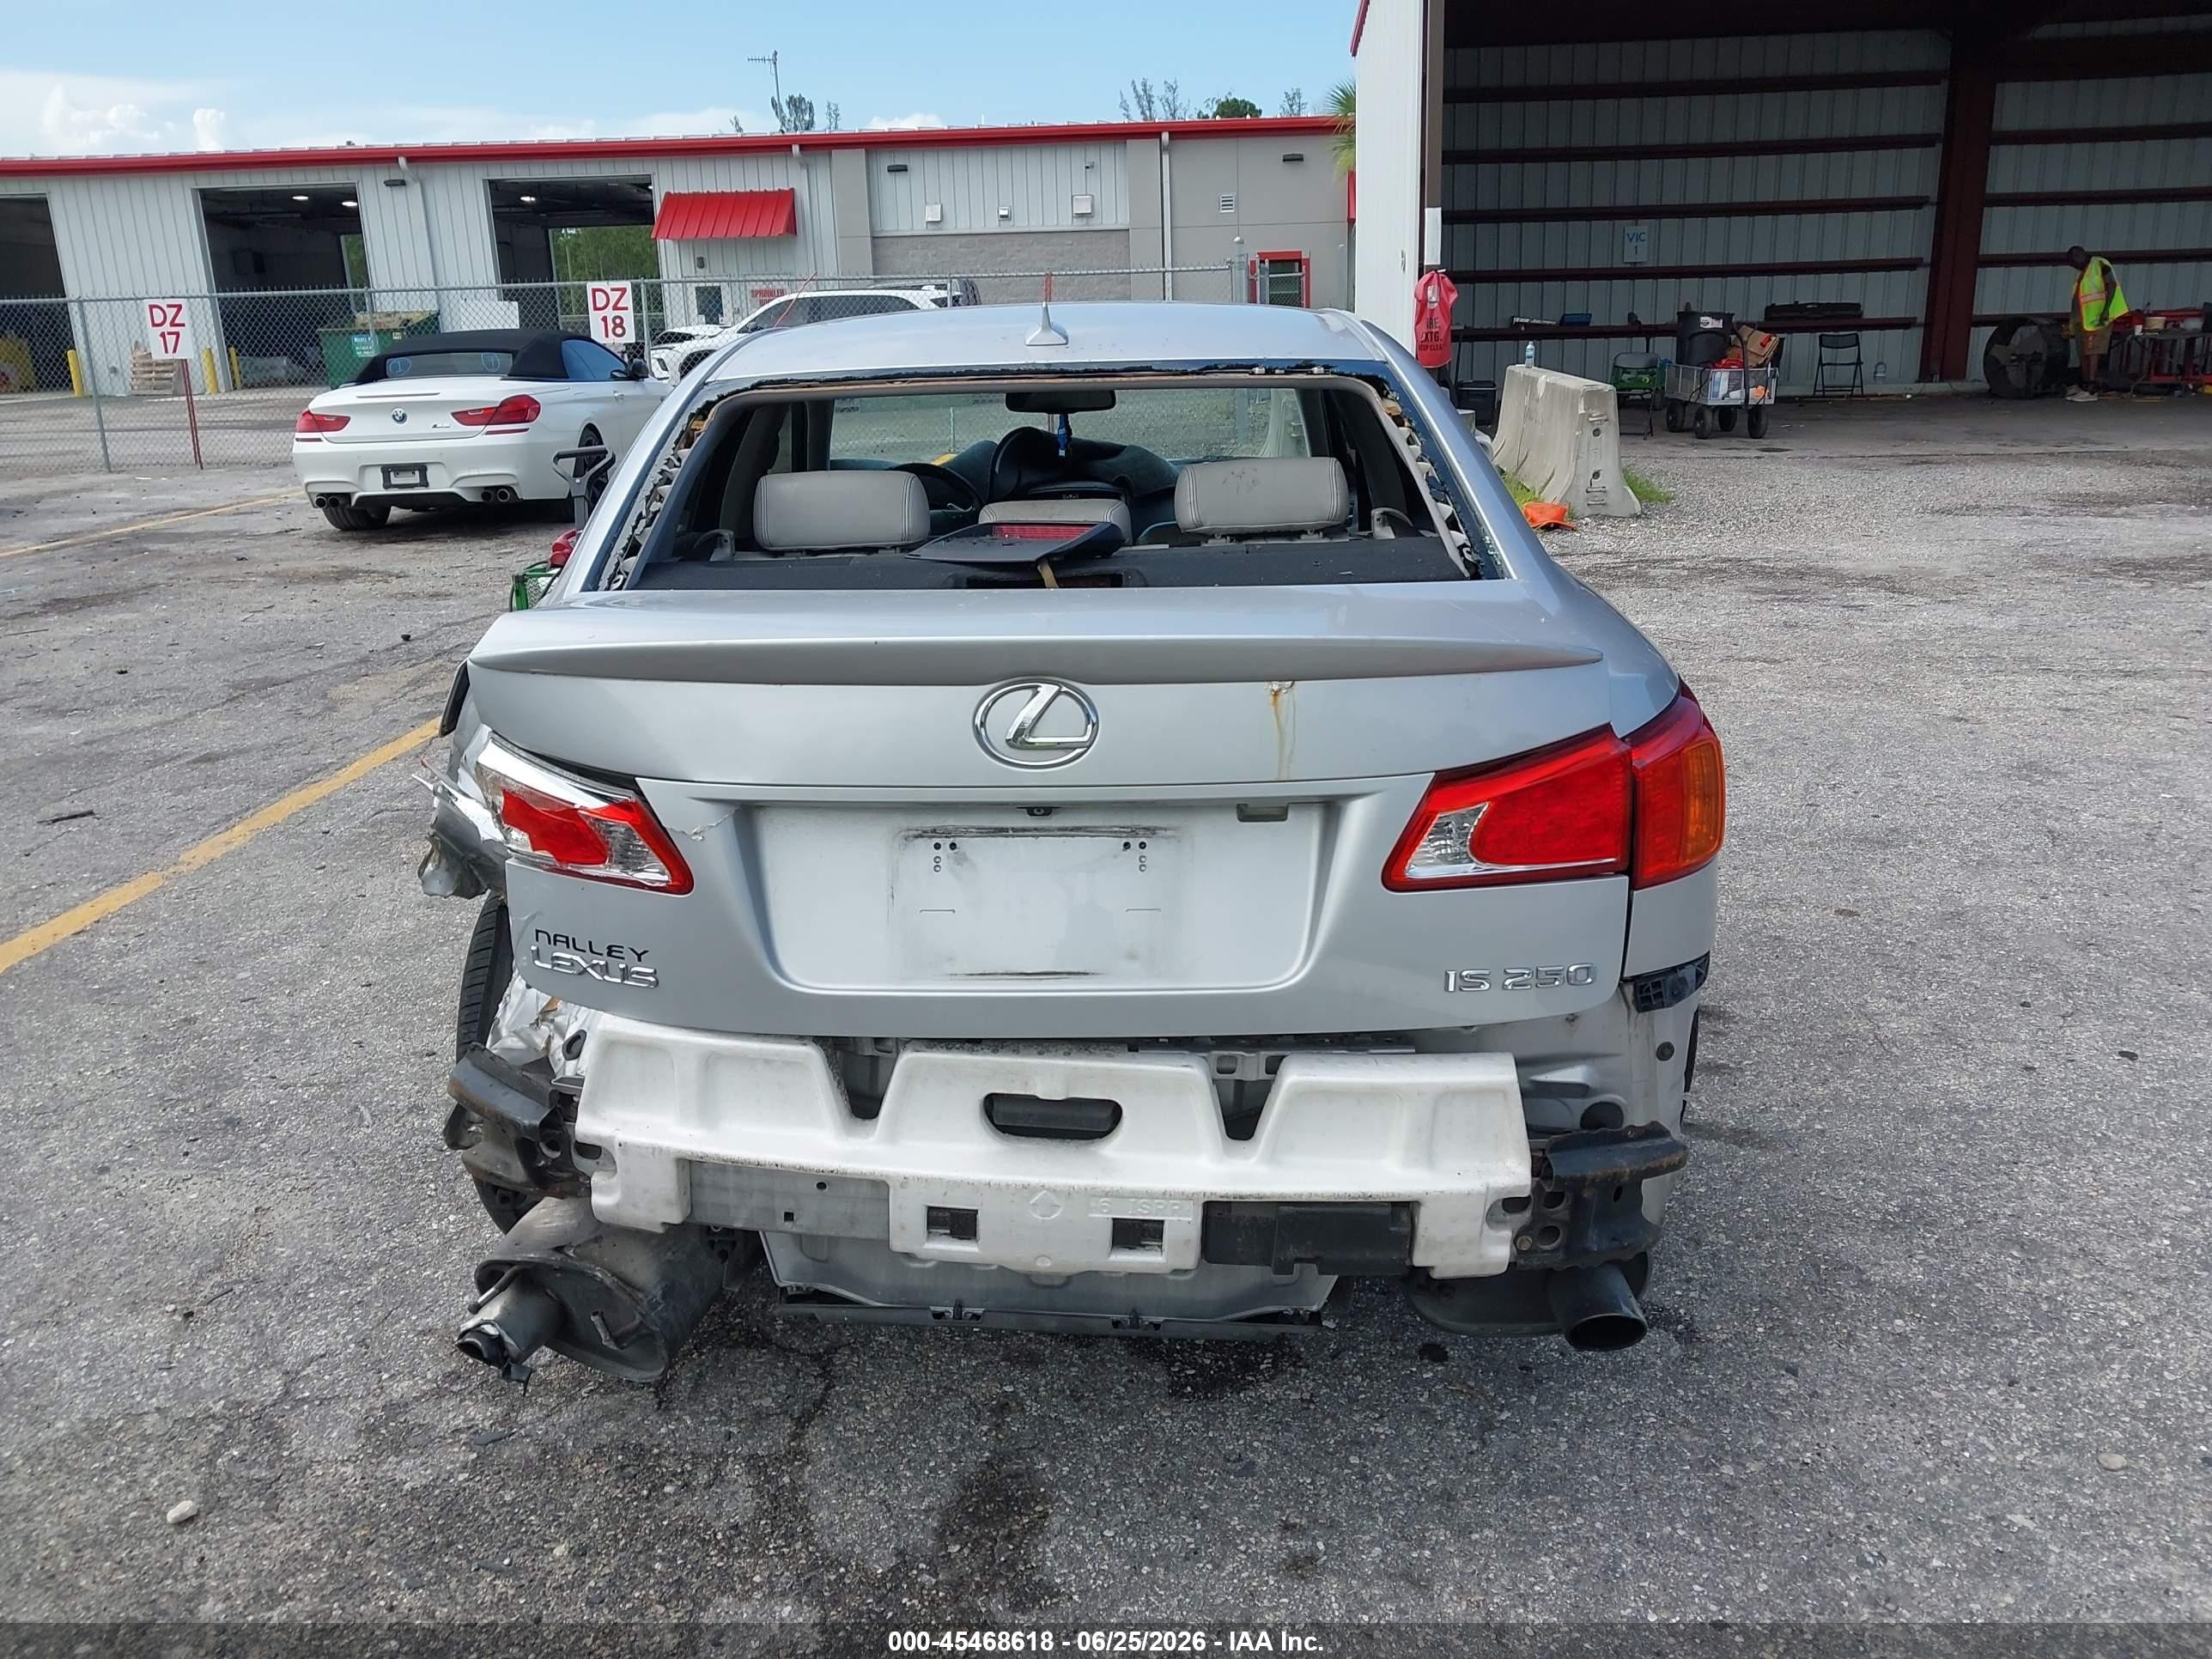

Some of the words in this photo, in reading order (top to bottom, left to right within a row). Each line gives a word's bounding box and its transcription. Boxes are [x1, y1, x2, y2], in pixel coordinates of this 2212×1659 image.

[1626, 232, 1646, 242] VIC
[592, 287, 629, 311] DZ
[148, 303, 185, 327] DZ
[600, 315, 626, 338] 18
[1425, 317, 1440, 330] IRE
[159, 331, 180, 354] 17
[535, 928, 649, 963] NALLEY
[530, 945, 659, 988] LEXUS
[1444, 969, 1492, 993] IS
[1502, 962, 1597, 992] 250
